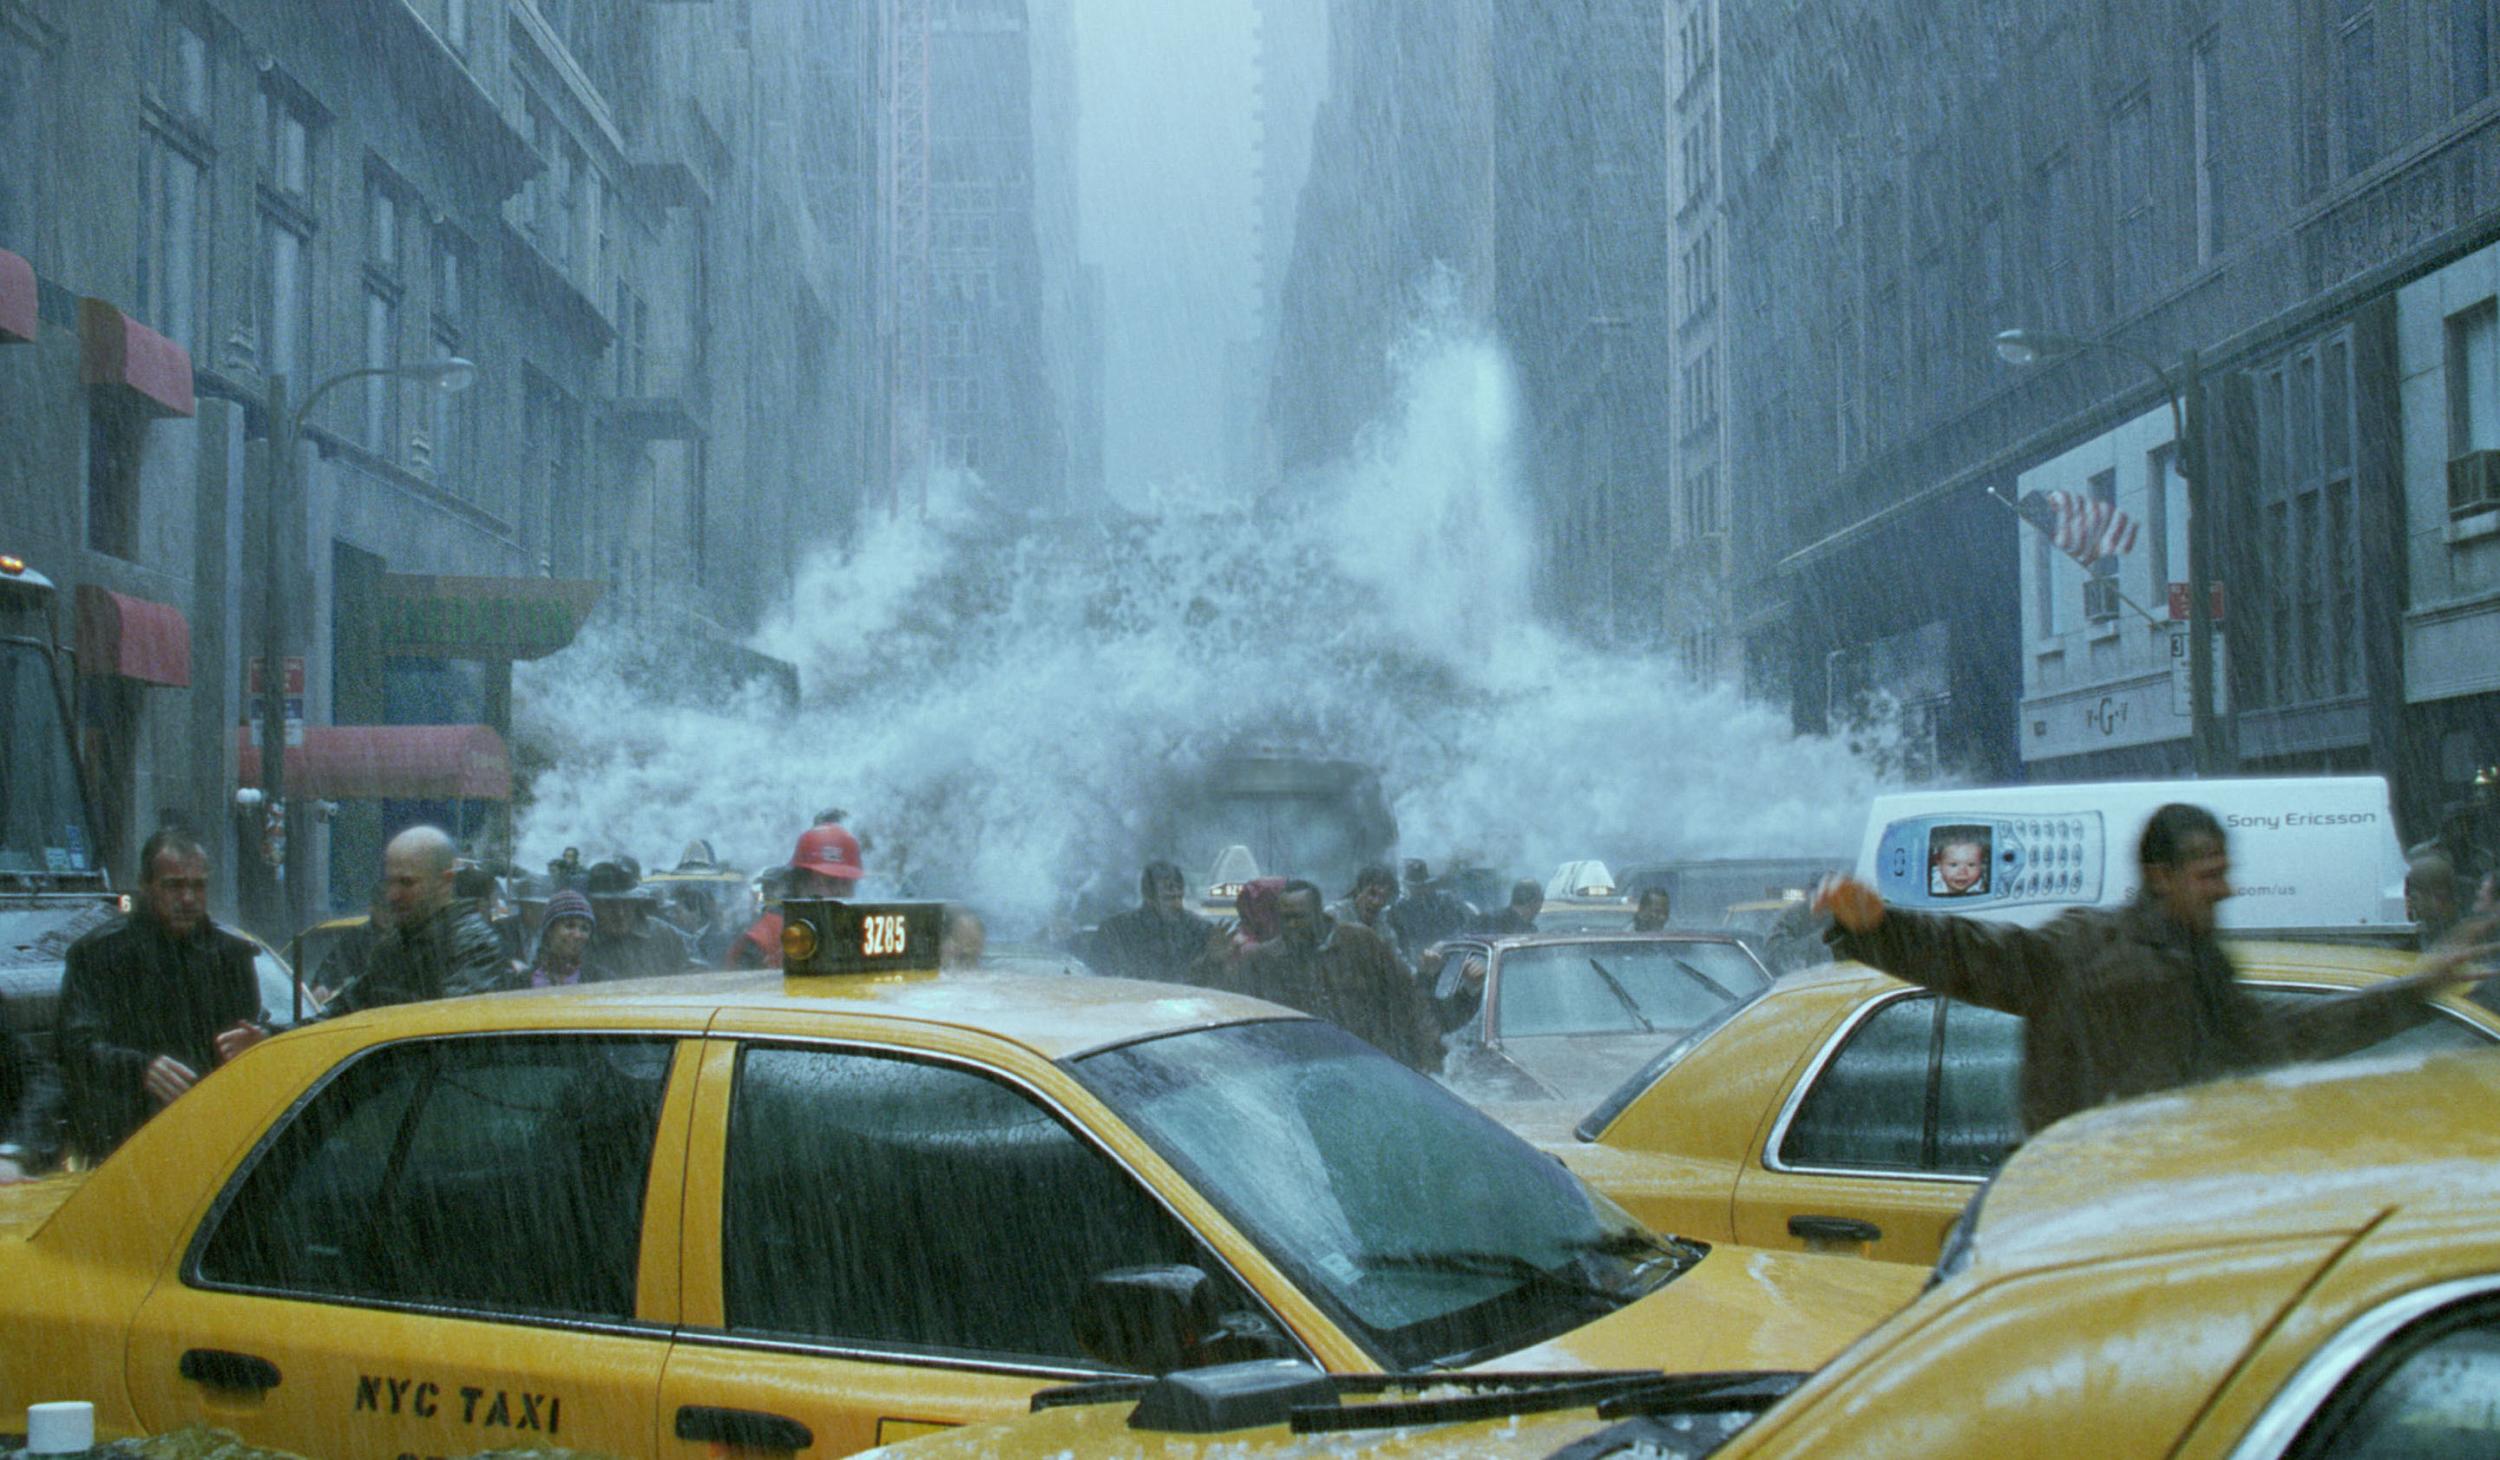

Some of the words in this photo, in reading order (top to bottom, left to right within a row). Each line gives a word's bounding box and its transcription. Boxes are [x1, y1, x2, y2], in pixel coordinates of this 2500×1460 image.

[2227, 815, 2279, 830] Sony
[2286, 813, 2376, 826] Ericsson
[355, 1375, 439, 1418] NYC
[460, 1386, 560, 1434] TAXI
